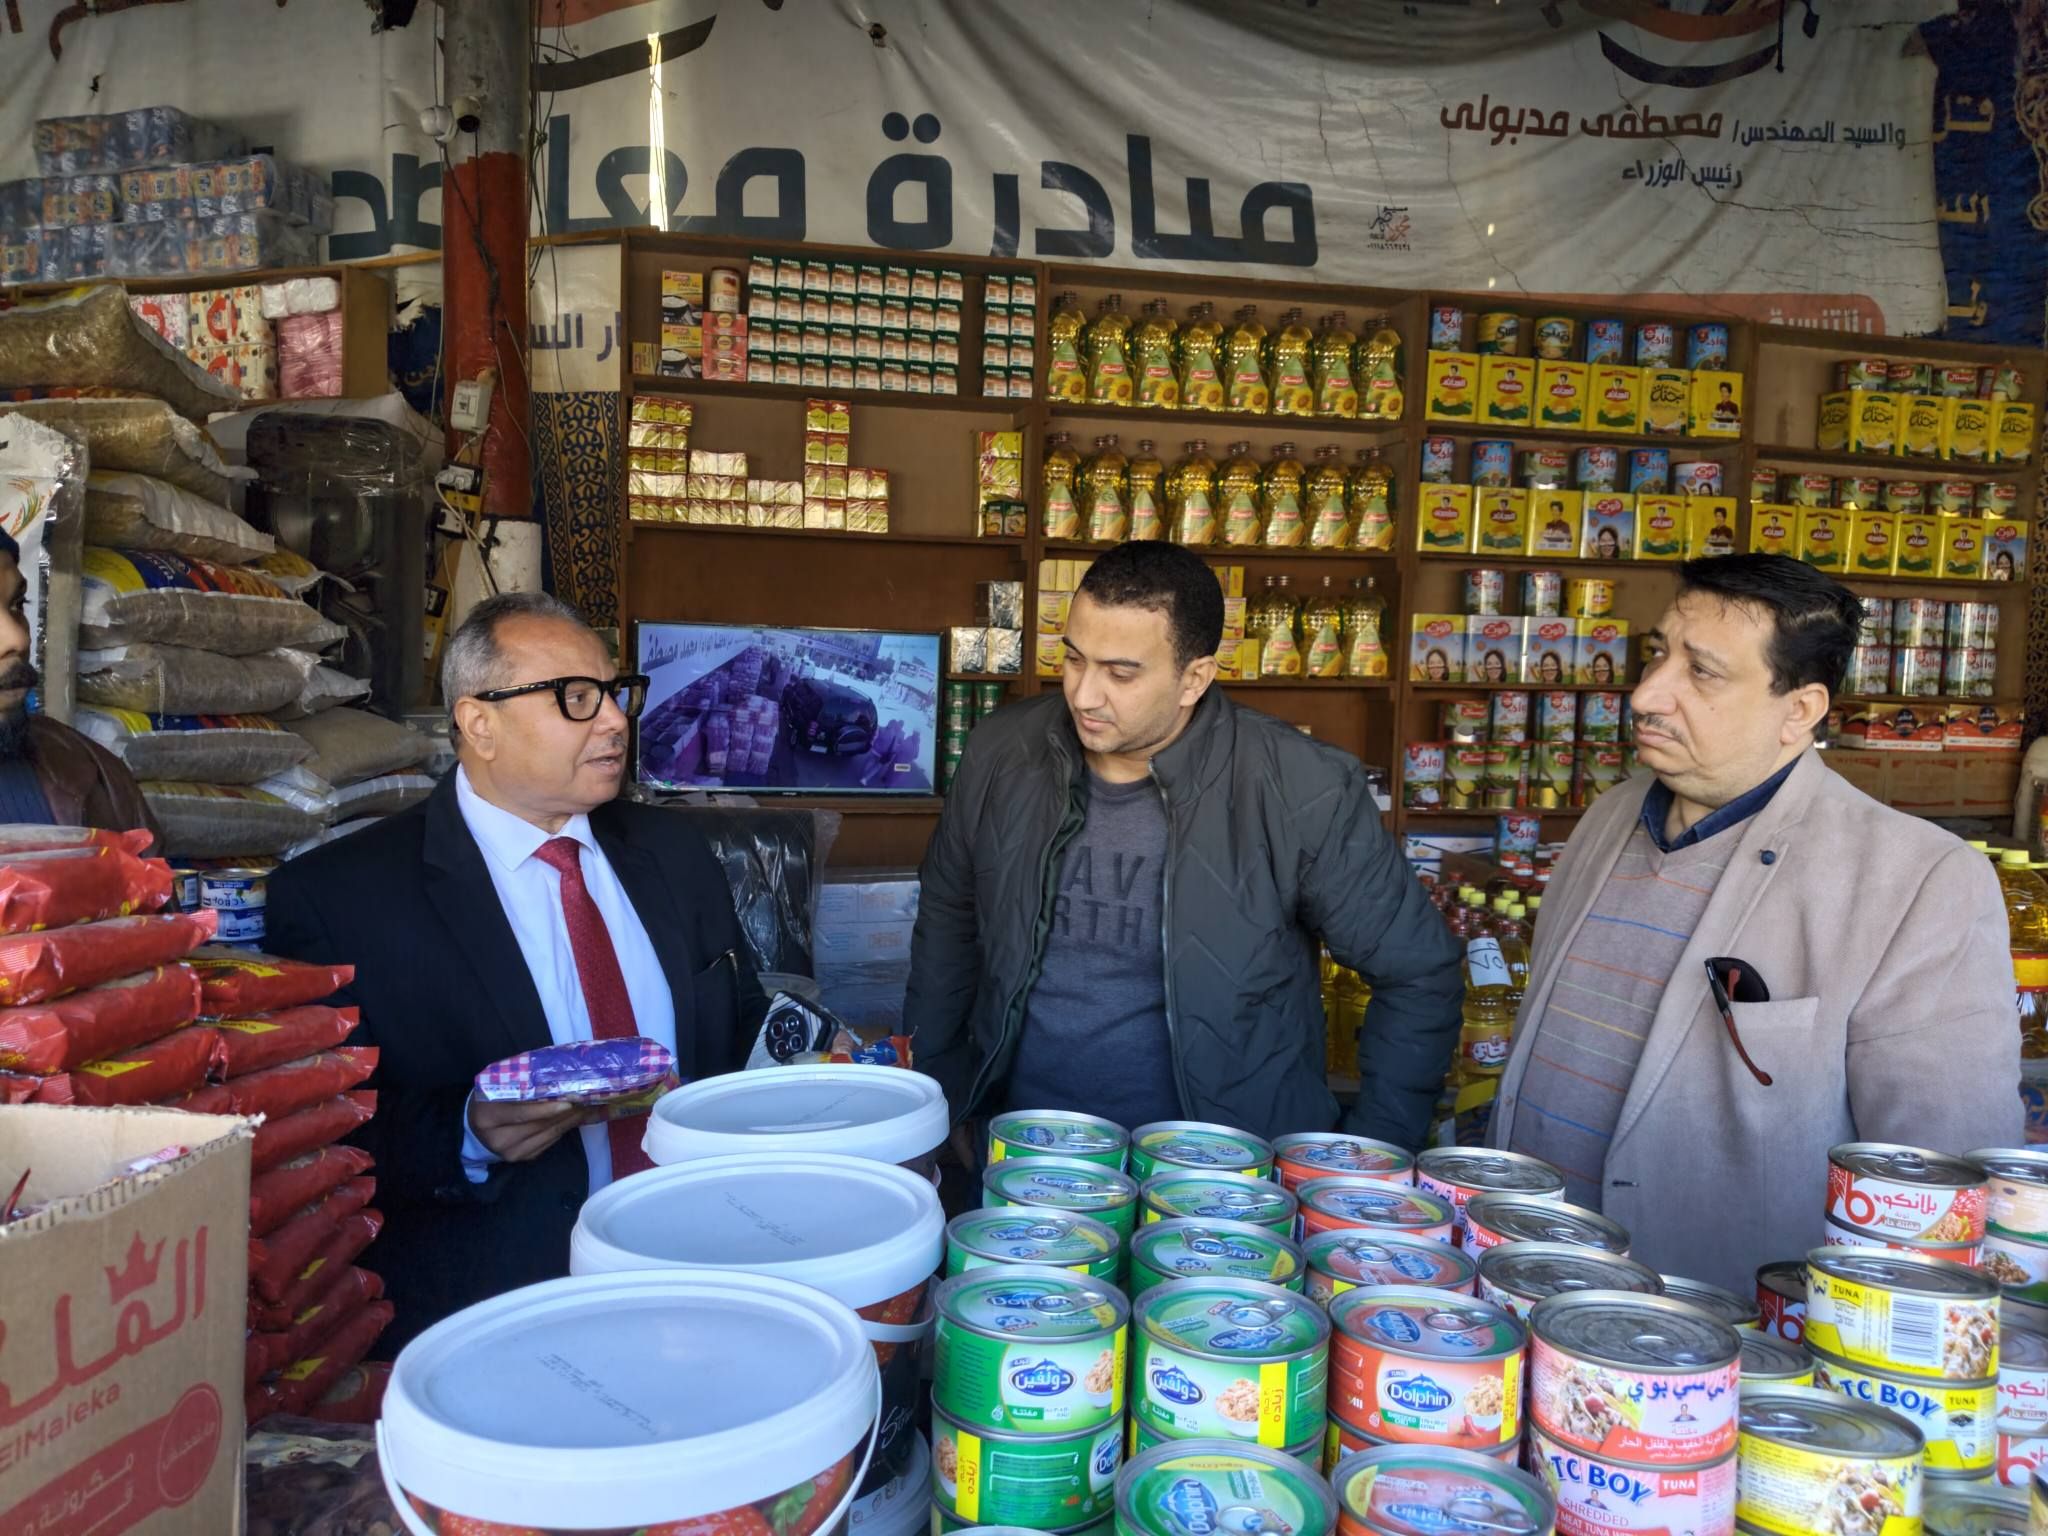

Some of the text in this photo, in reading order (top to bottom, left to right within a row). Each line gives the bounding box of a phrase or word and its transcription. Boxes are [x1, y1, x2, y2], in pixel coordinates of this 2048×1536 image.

[1580, 105, 1724, 139] مصطفى
[1843, 120, 1907, 150] والسيد
[1621, 158, 1743, 190] رئيس الوزراء
[1882, 1192, 1938, 1216] بلانكو
[1833, 1283, 1861, 1300] TUNA
[1014, 1370, 1072, 1391] دولفين
[1153, 1372, 1200, 1400] دولفين
[1390, 1383, 1450, 1408] Dolphin
[1839, 1379, 1941, 1418] TC BOY
[1949, 1396, 1977, 1406] TUNA
[1550, 1455, 1653, 1503] TC BOY
[1662, 1479, 1697, 1490] TUNA
[1563, 1496, 1630, 1528] SHREDDED
